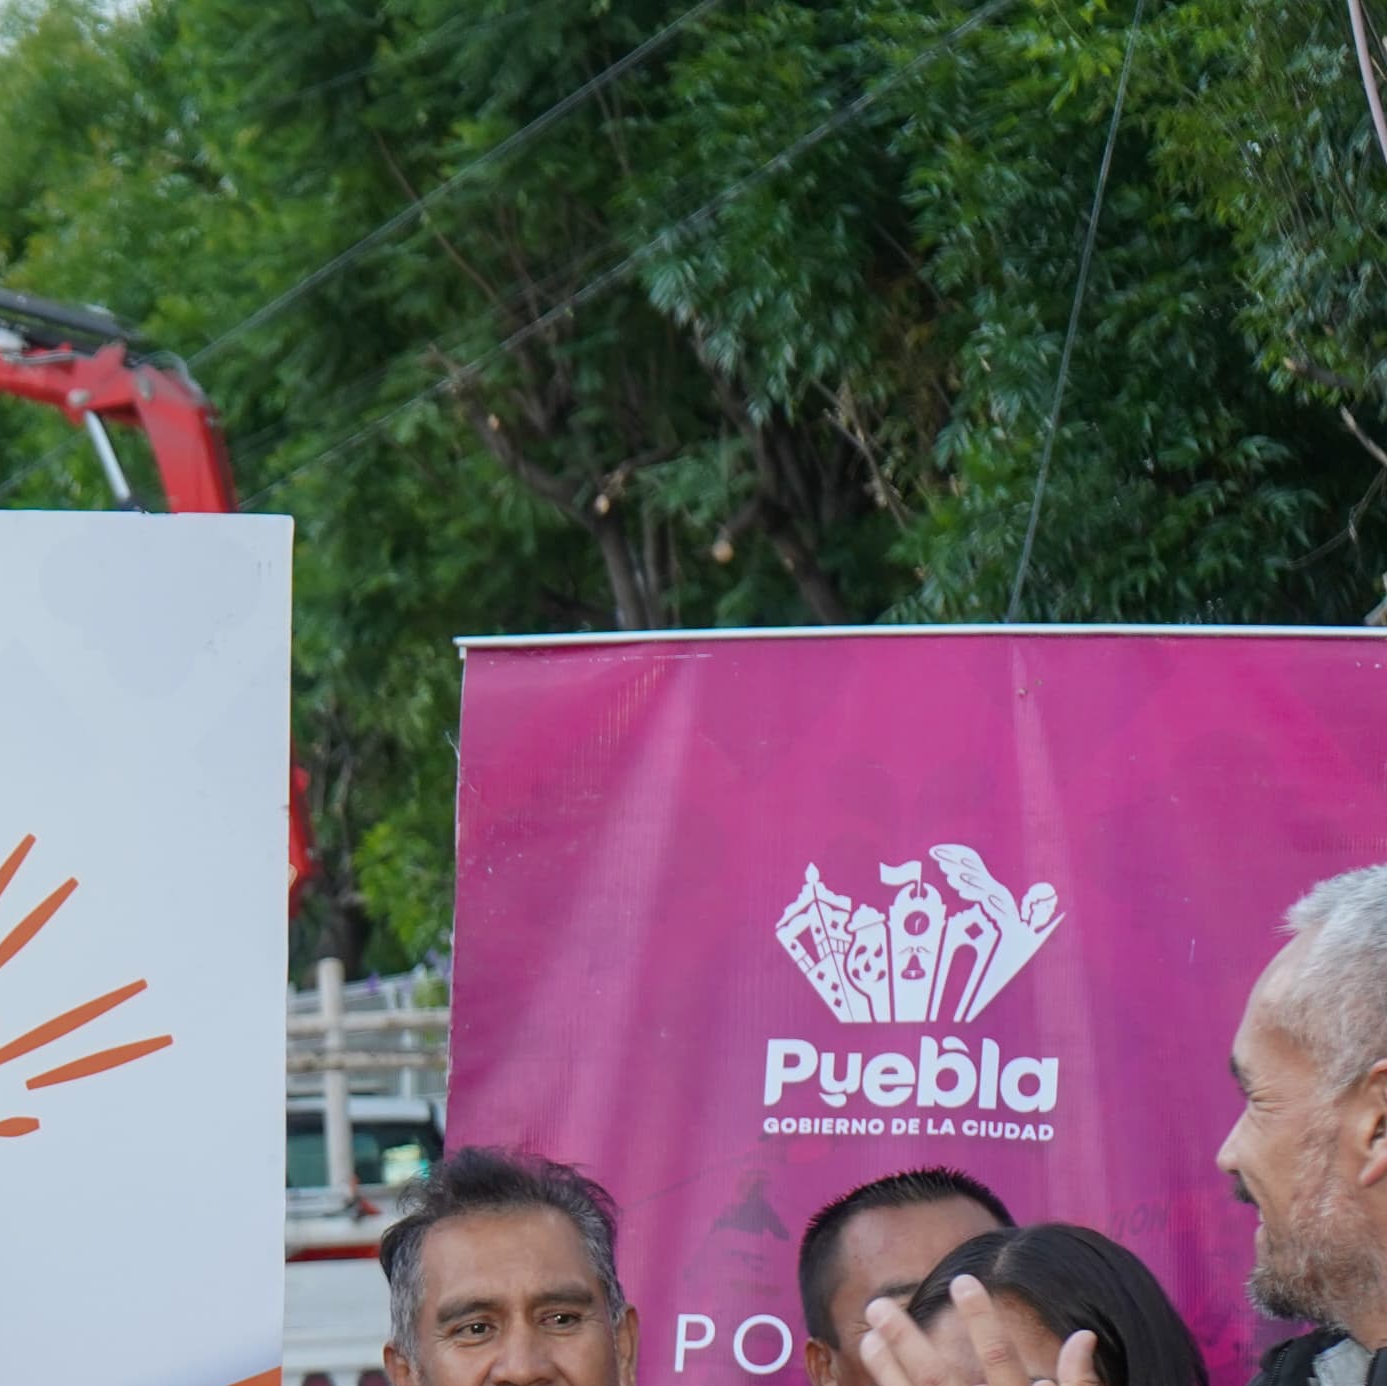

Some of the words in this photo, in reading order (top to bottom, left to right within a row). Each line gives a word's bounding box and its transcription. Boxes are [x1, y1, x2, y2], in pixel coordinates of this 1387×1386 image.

[764, 1036, 1059, 1112] Puebla
[763, 1117, 885, 1136] GOBIERNO
[891, 1118, 920, 1136] DE
[927, 1118, 956, 1136] LA
[962, 1119, 1055, 1141] CIUDAD
